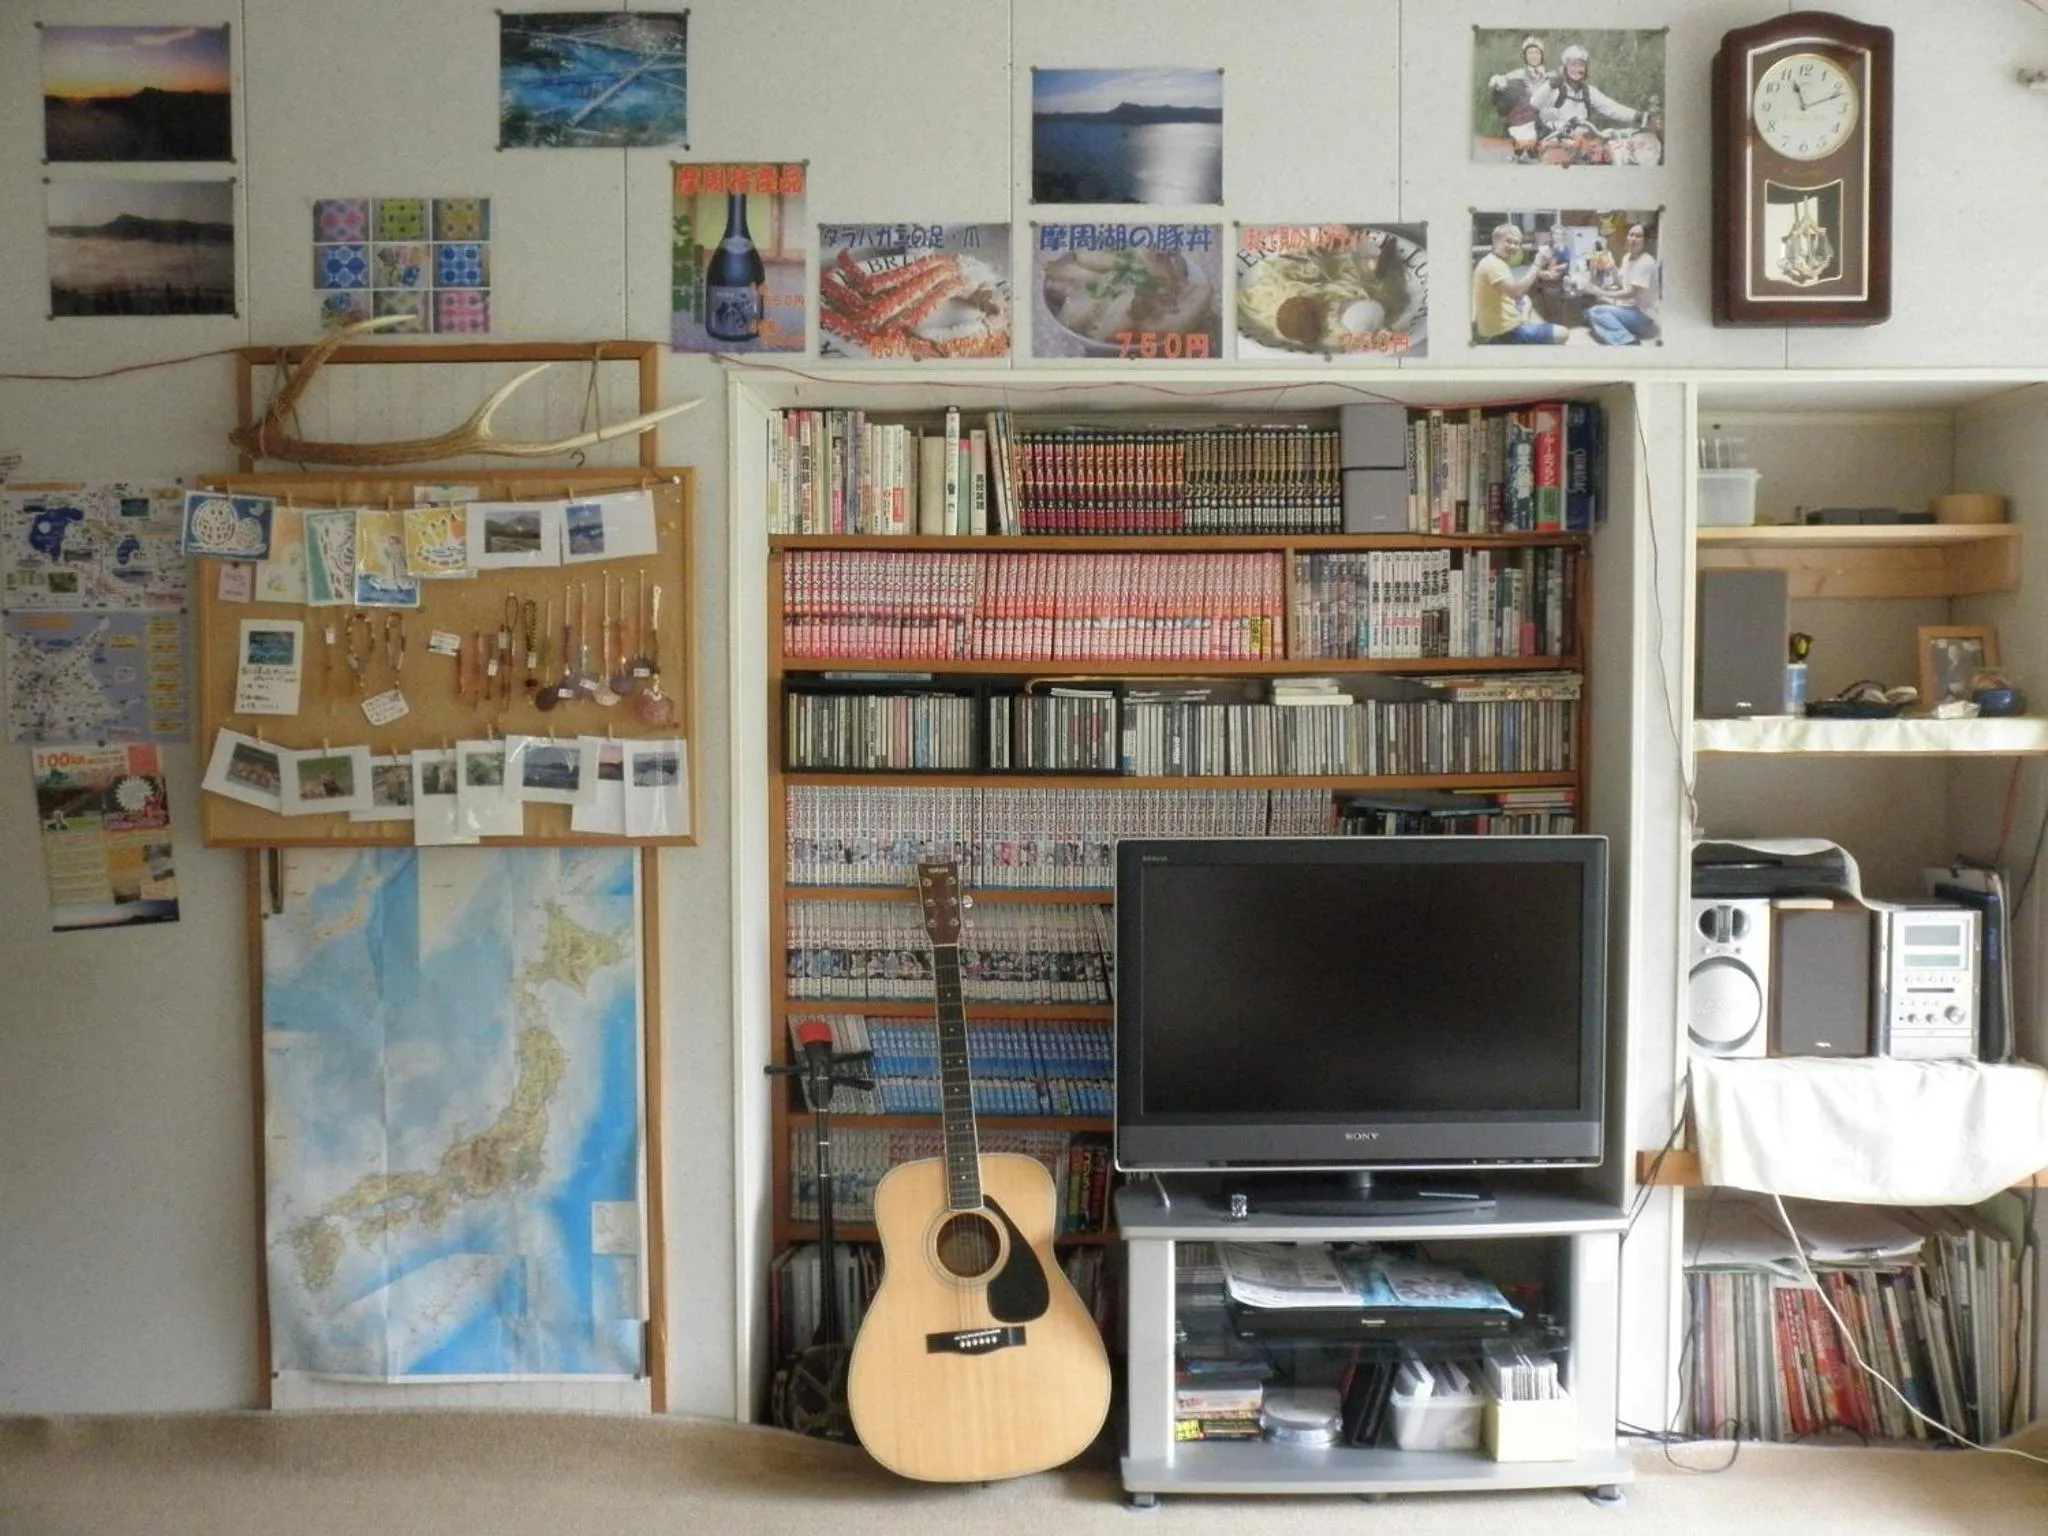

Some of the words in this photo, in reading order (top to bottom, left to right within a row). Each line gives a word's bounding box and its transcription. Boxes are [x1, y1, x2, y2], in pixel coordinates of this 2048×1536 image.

[1780, 68, 1793, 81] 11
[1798, 63, 1814, 76] 12
[1820, 69, 1827, 82] 1
[1765, 81, 1780, 94] 10
[1832, 82, 1843, 93] 2
[1761, 102, 1772, 112] 9
[1838, 102, 1848, 114] 3
[1766, 121, 1776, 132] 8
[1831, 122, 1841, 133] 4
[1780, 135, 1791, 148] 7
[1798, 140, 1809, 153] 6
[1815, 135, 1827, 148] 5
[1039, 224, 1212, 251] 摩周湖の豚丼
[1115, 332, 1209, 358] 750円
[1345, 1131, 1379, 1141] SONY
